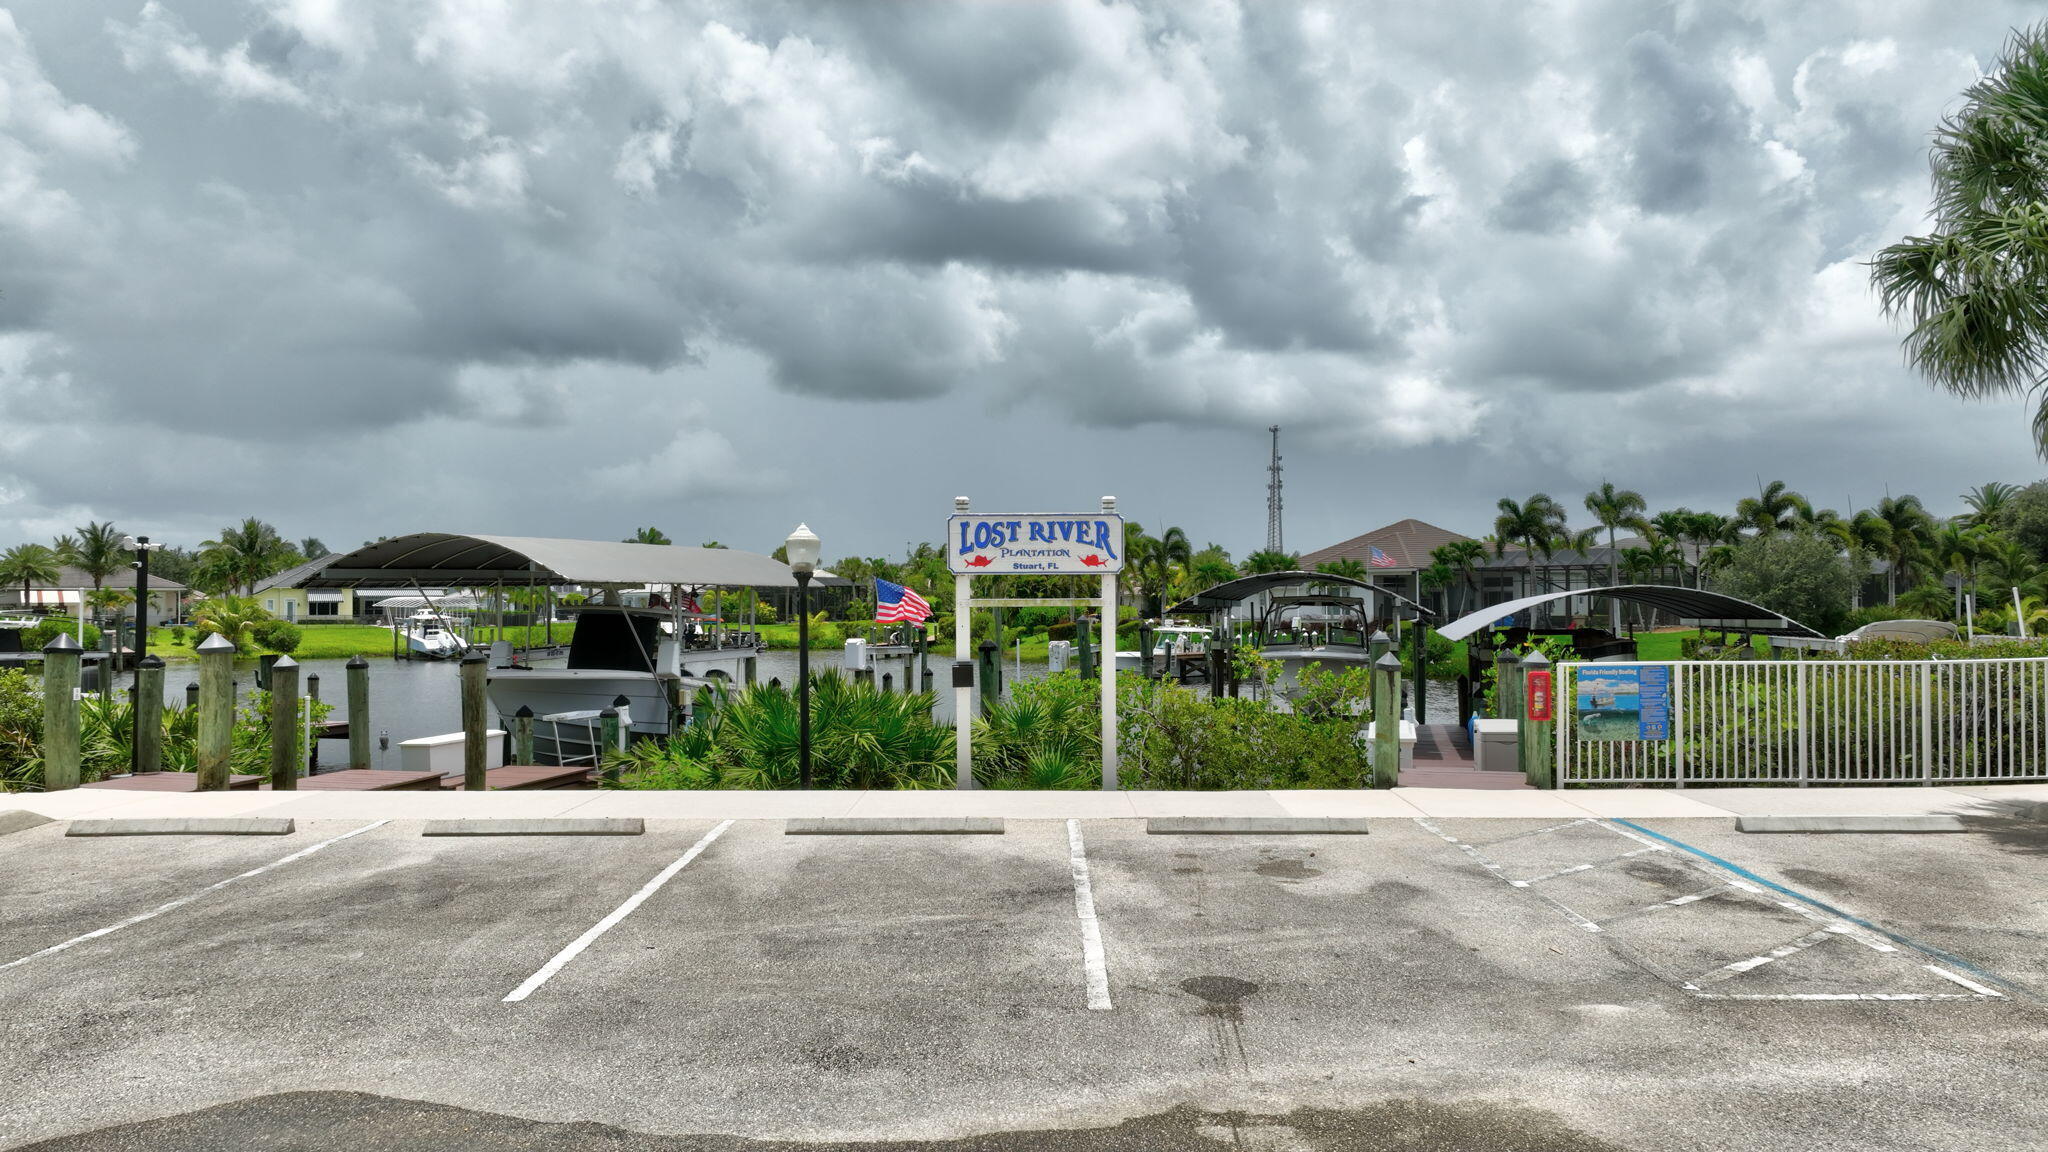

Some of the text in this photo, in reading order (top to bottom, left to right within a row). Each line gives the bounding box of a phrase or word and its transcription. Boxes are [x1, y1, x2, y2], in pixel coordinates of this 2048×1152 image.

[959, 520, 1118, 560] LOST RIVER
[1000, 548, 1071, 558] PLANTATION
